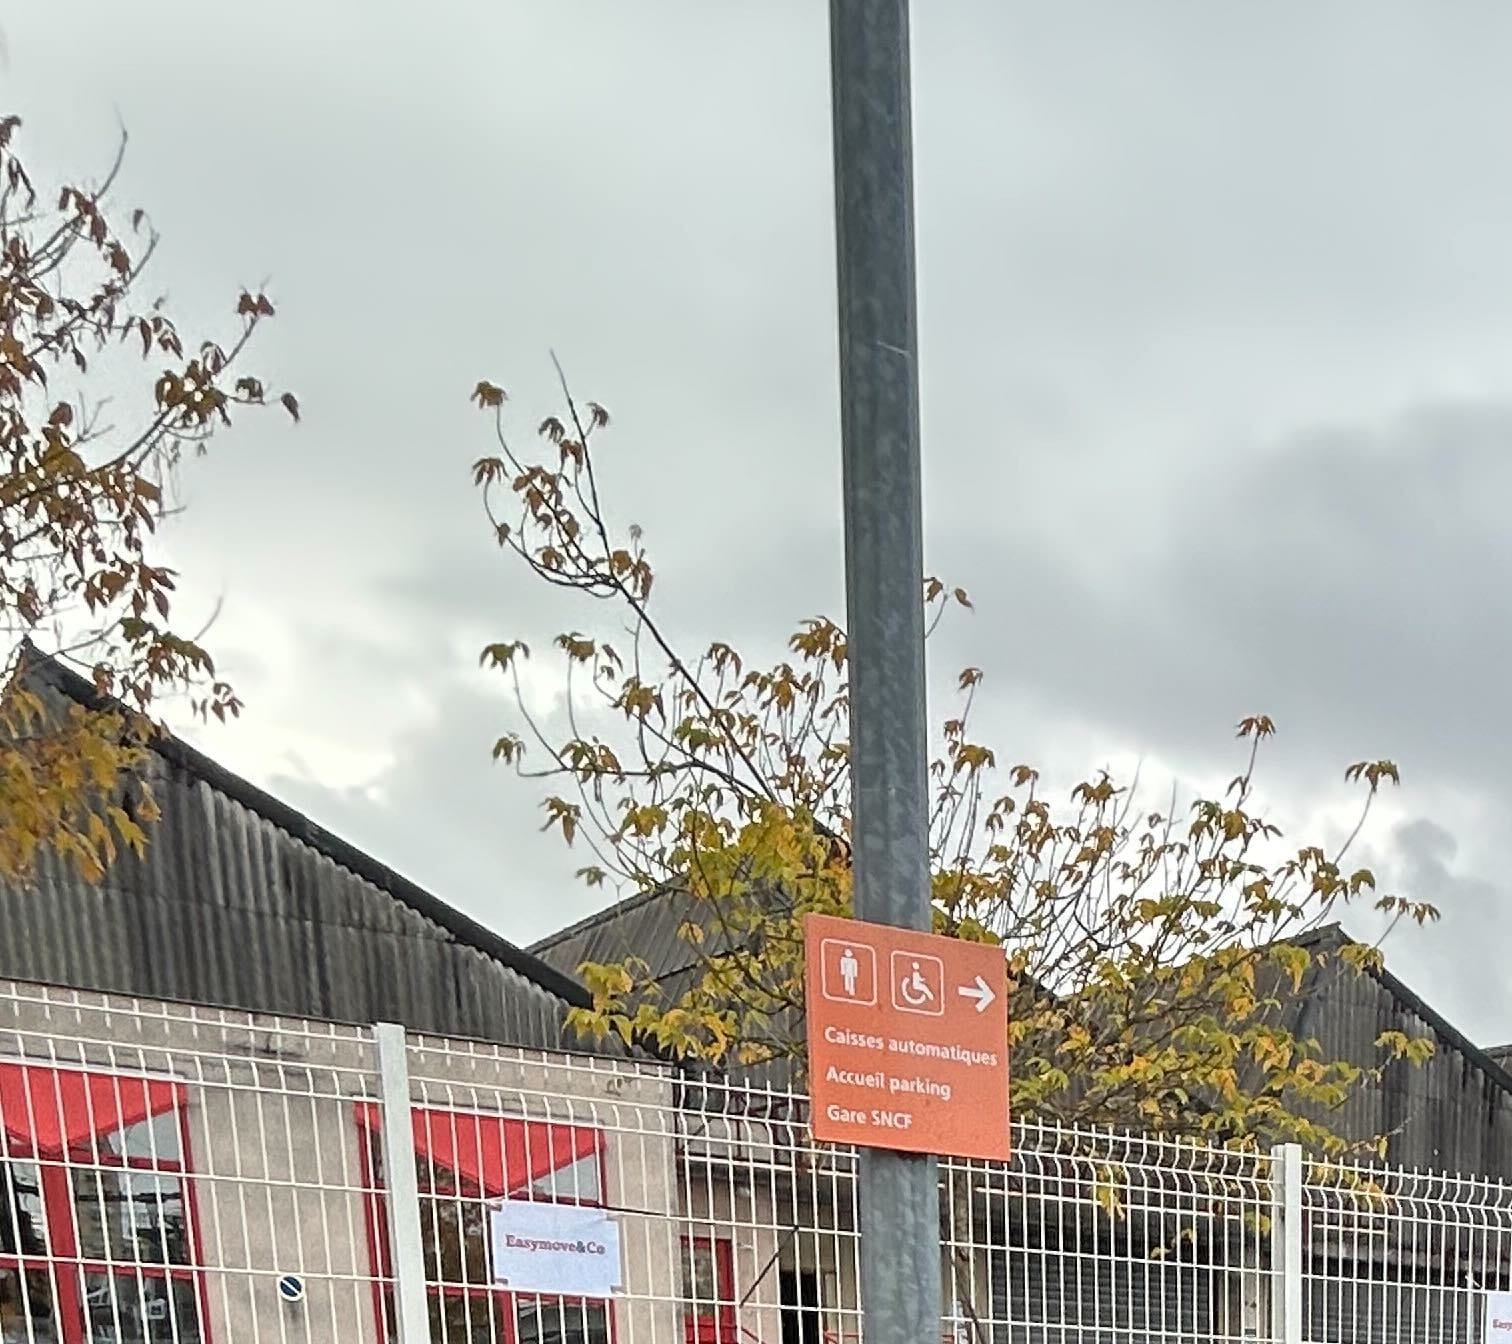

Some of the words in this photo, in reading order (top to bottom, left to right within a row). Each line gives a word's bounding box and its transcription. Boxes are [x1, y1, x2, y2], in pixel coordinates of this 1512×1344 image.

[824, 1026, 884, 1050] Caisses
[888, 1039, 998, 1067] automatiques
[826, 1066, 885, 1089] Accueil
[889, 1078, 952, 1100] parking
[826, 1104, 867, 1125] Gare
[870, 1110, 913, 1130] SNCF
[505, 1234, 606, 1255] Easymove&Co
